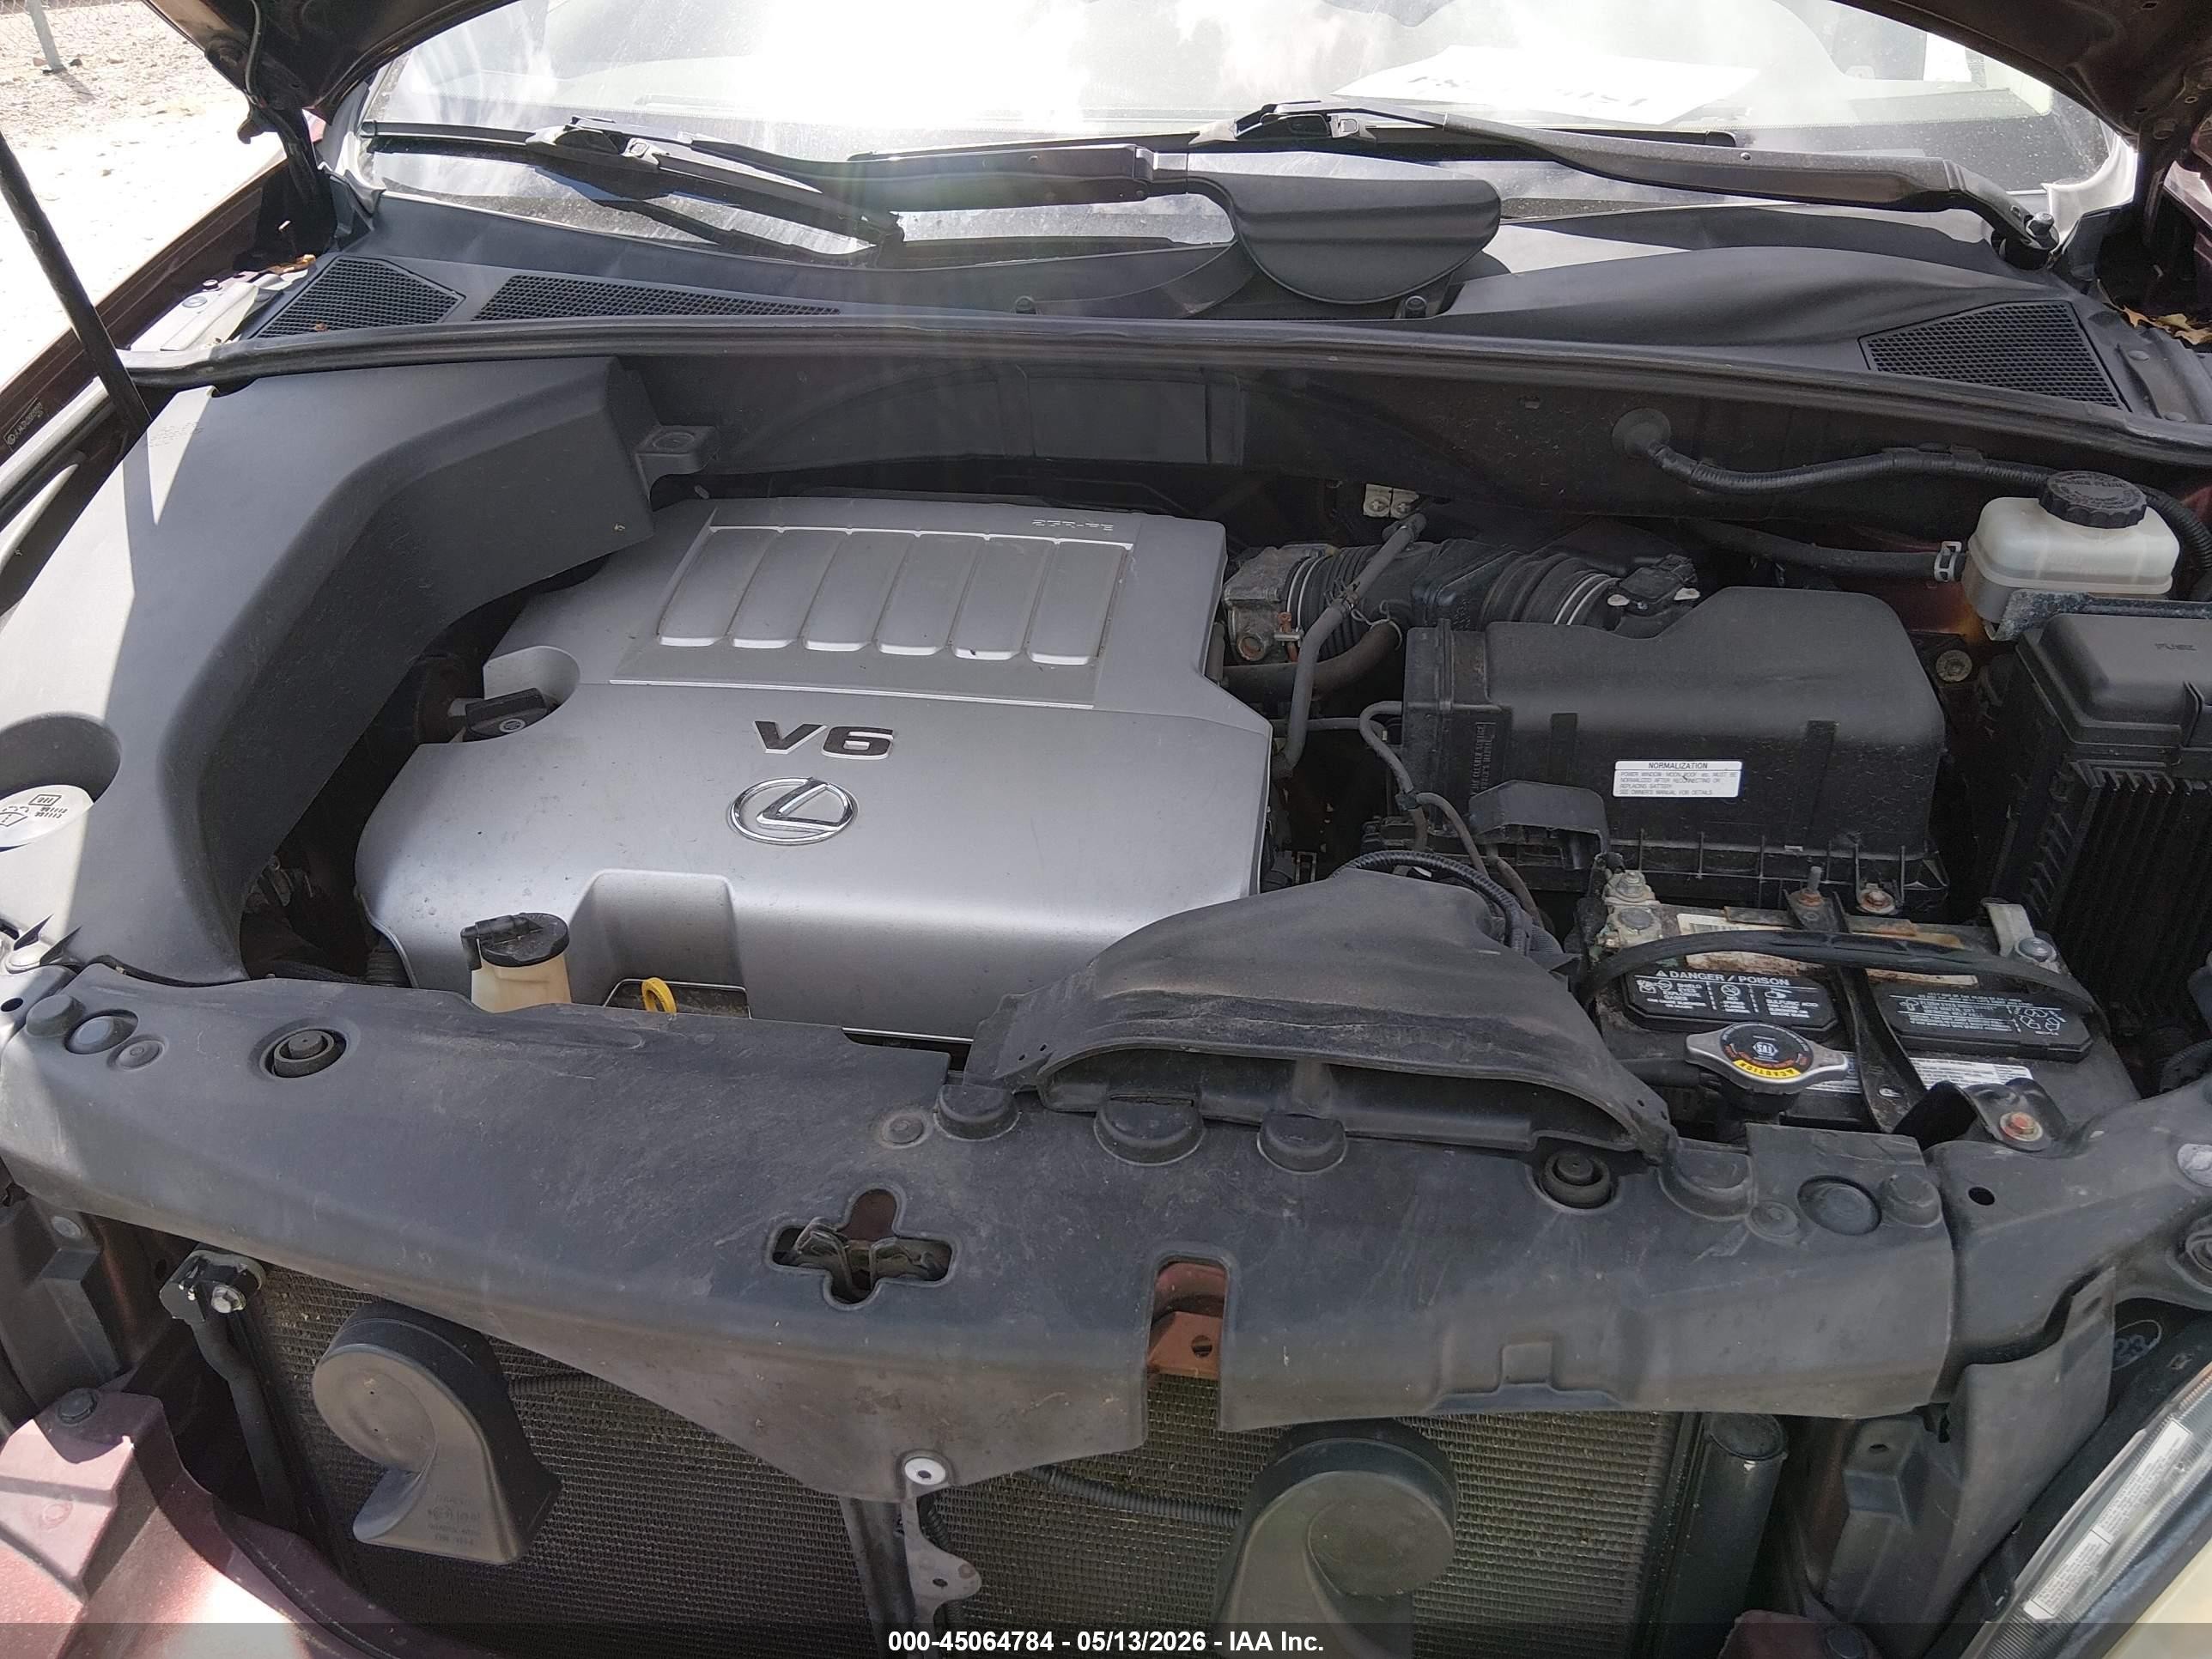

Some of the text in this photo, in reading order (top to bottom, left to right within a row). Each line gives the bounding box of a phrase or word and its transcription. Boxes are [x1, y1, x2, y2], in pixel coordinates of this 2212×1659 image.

[753, 720, 894, 761] V6
[1669, 970, 1724, 981] DANGER
[1739, 975, 1790, 986] POISON
